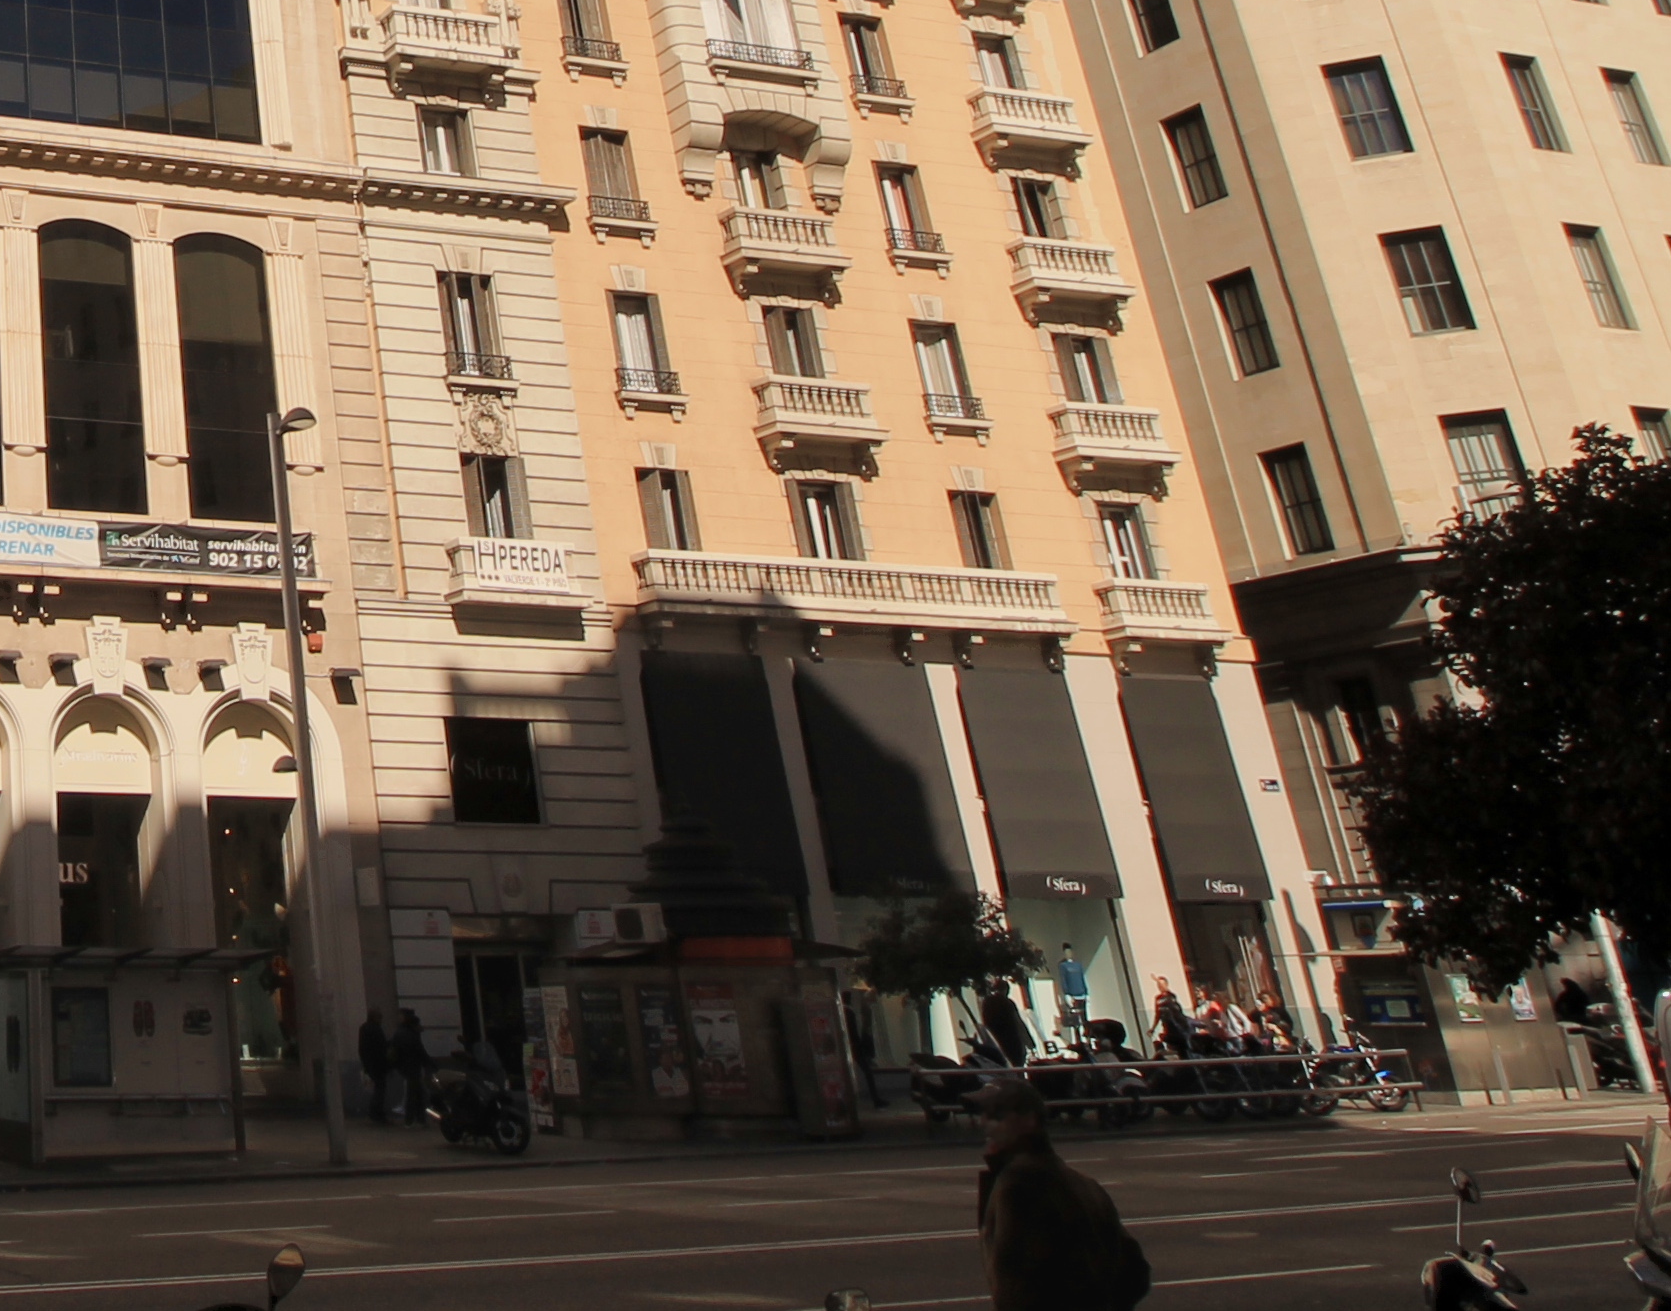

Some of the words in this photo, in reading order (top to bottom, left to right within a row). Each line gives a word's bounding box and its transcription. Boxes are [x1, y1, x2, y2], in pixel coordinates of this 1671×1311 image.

[121, 532, 200, 552] Servihabitat
[209, 551, 239, 568] 902
[244, 554, 263, 569] 15
[498, 544, 564, 574] PEREDA
